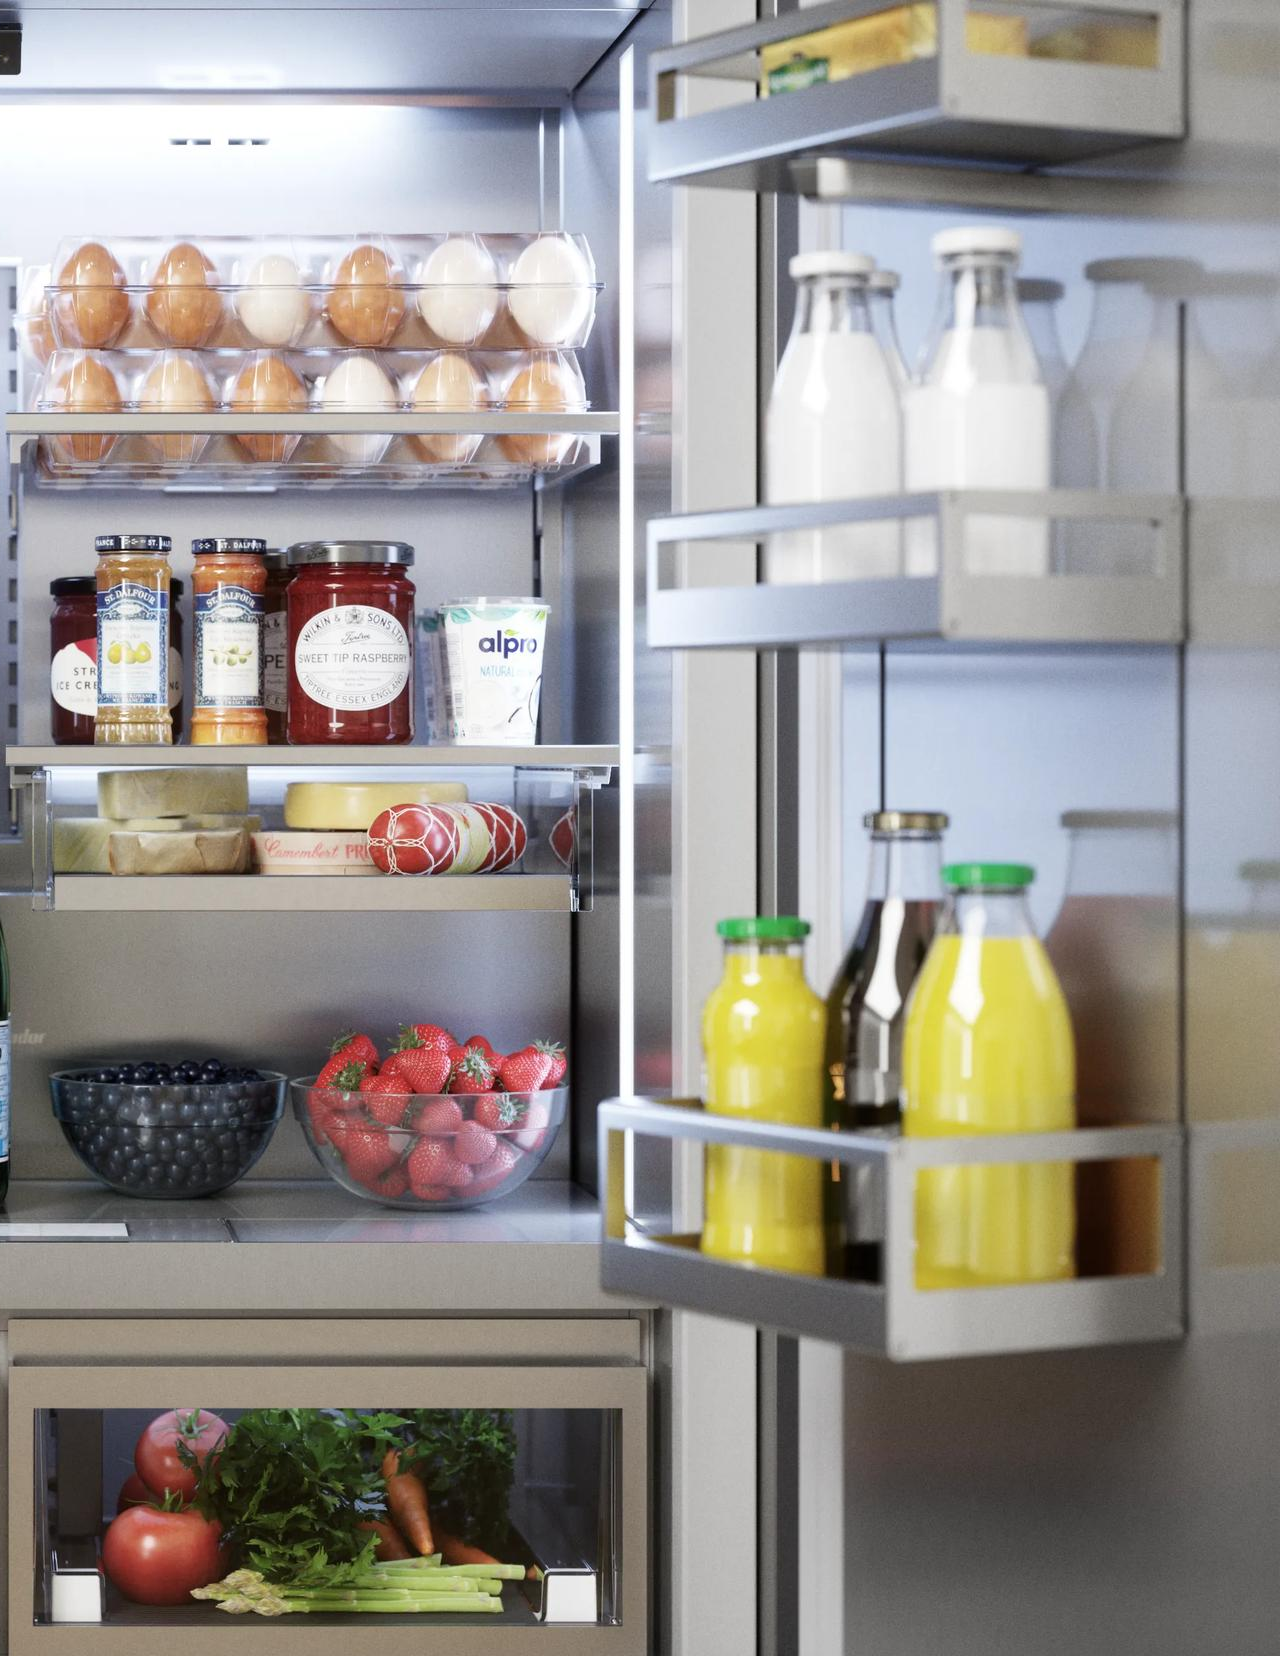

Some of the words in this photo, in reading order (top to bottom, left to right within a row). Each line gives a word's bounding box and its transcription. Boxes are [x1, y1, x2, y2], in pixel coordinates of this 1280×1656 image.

[115, 588, 157, 606] DALFOUR
[218, 591, 256, 609] DALFOUR
[302, 614, 331, 643] WILKIN
[367, 613, 392, 631] SONS
[478, 629, 538, 659] alpro
[297, 653, 329, 664] SWEET
[333, 653, 347, 663] TIP
[352, 653, 408, 664] RASPBERRY
[56, 681, 71, 691] ICE
[303, 674, 331, 700] TIPTREE
[335, 694, 368, 705] ESSEX
[370, 674, 405, 703] ENGLAND
[264, 837, 339, 858] Camembert
